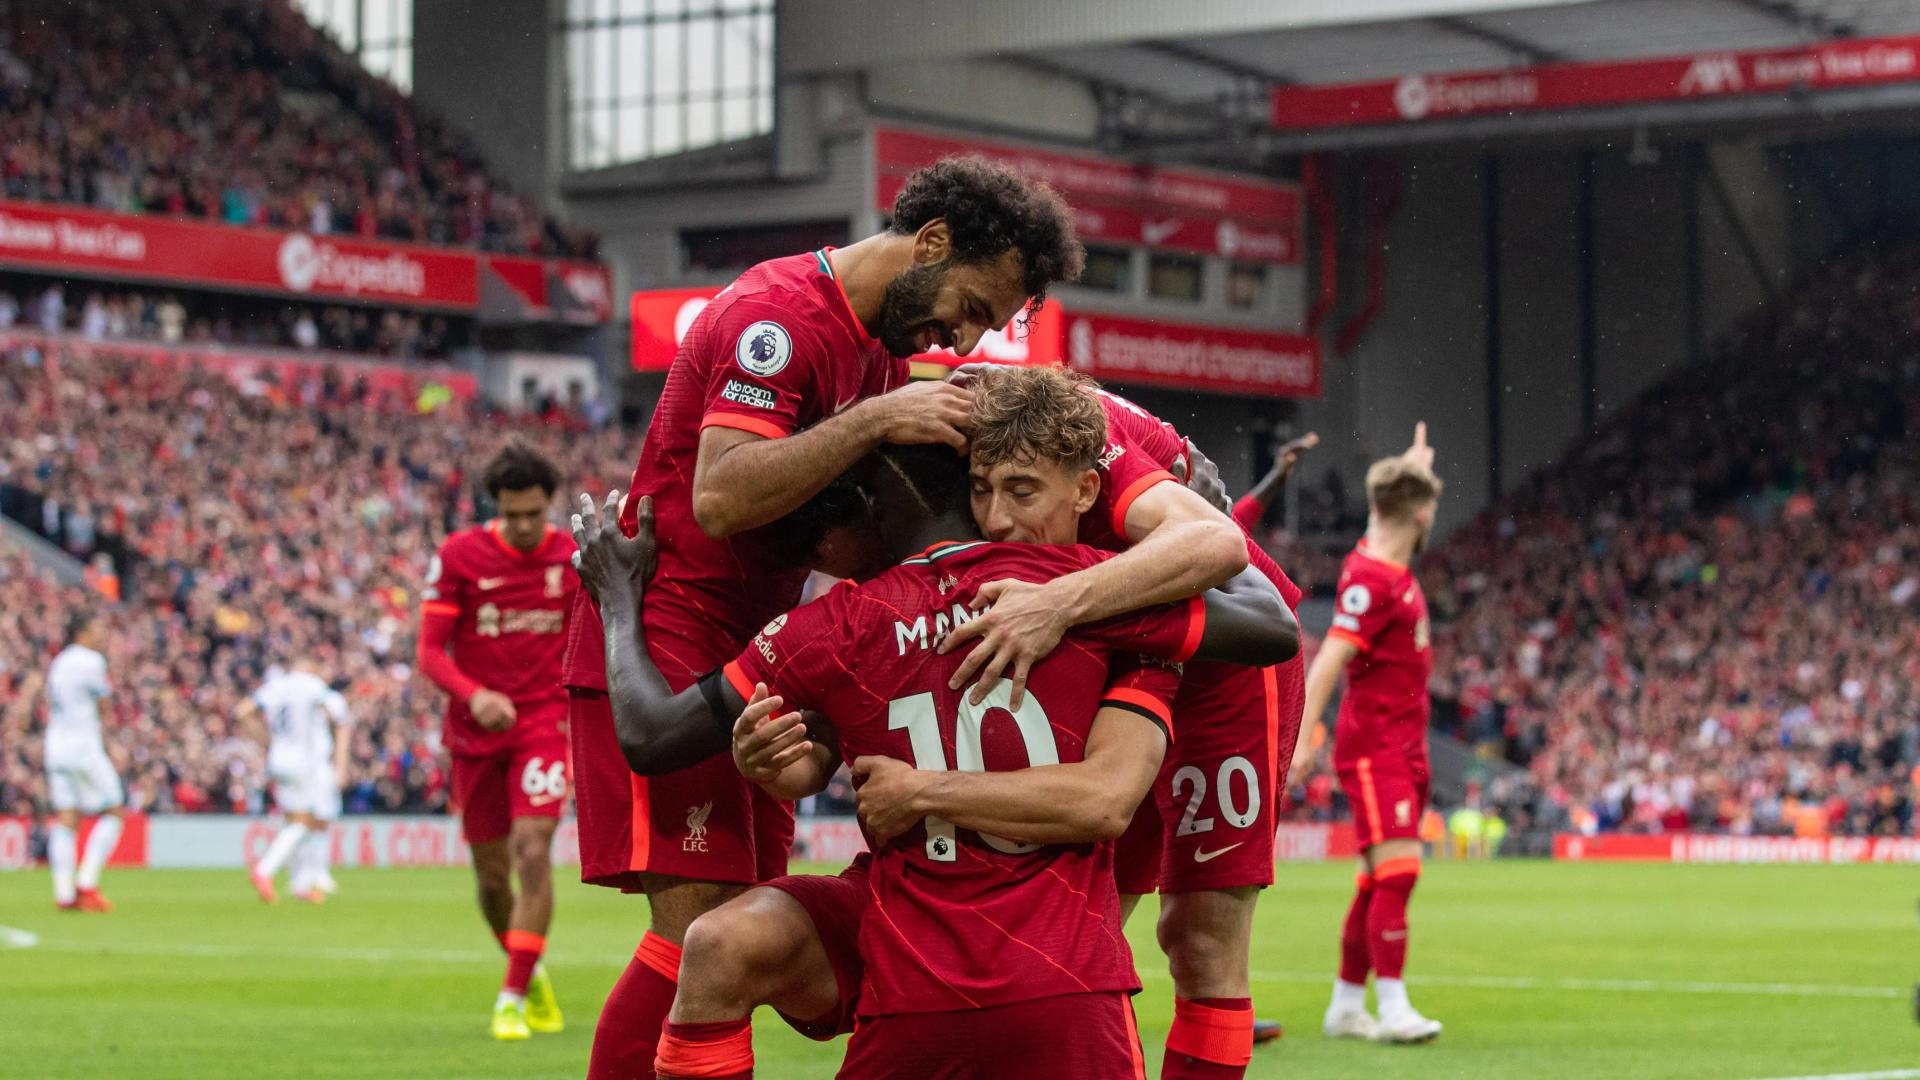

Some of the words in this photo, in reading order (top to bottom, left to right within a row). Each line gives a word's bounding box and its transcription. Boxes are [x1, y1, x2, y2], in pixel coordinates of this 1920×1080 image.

[721, 389, 739, 401] for
[738, 392, 775, 410] racism
[726, 379, 741, 390] No
[741, 384, 772, 400] room
[895, 603, 991, 656] MAN
[521, 757, 566, 798] 66
[888, 677, 1060, 862] 10
[1172, 756, 1261, 837] 20
